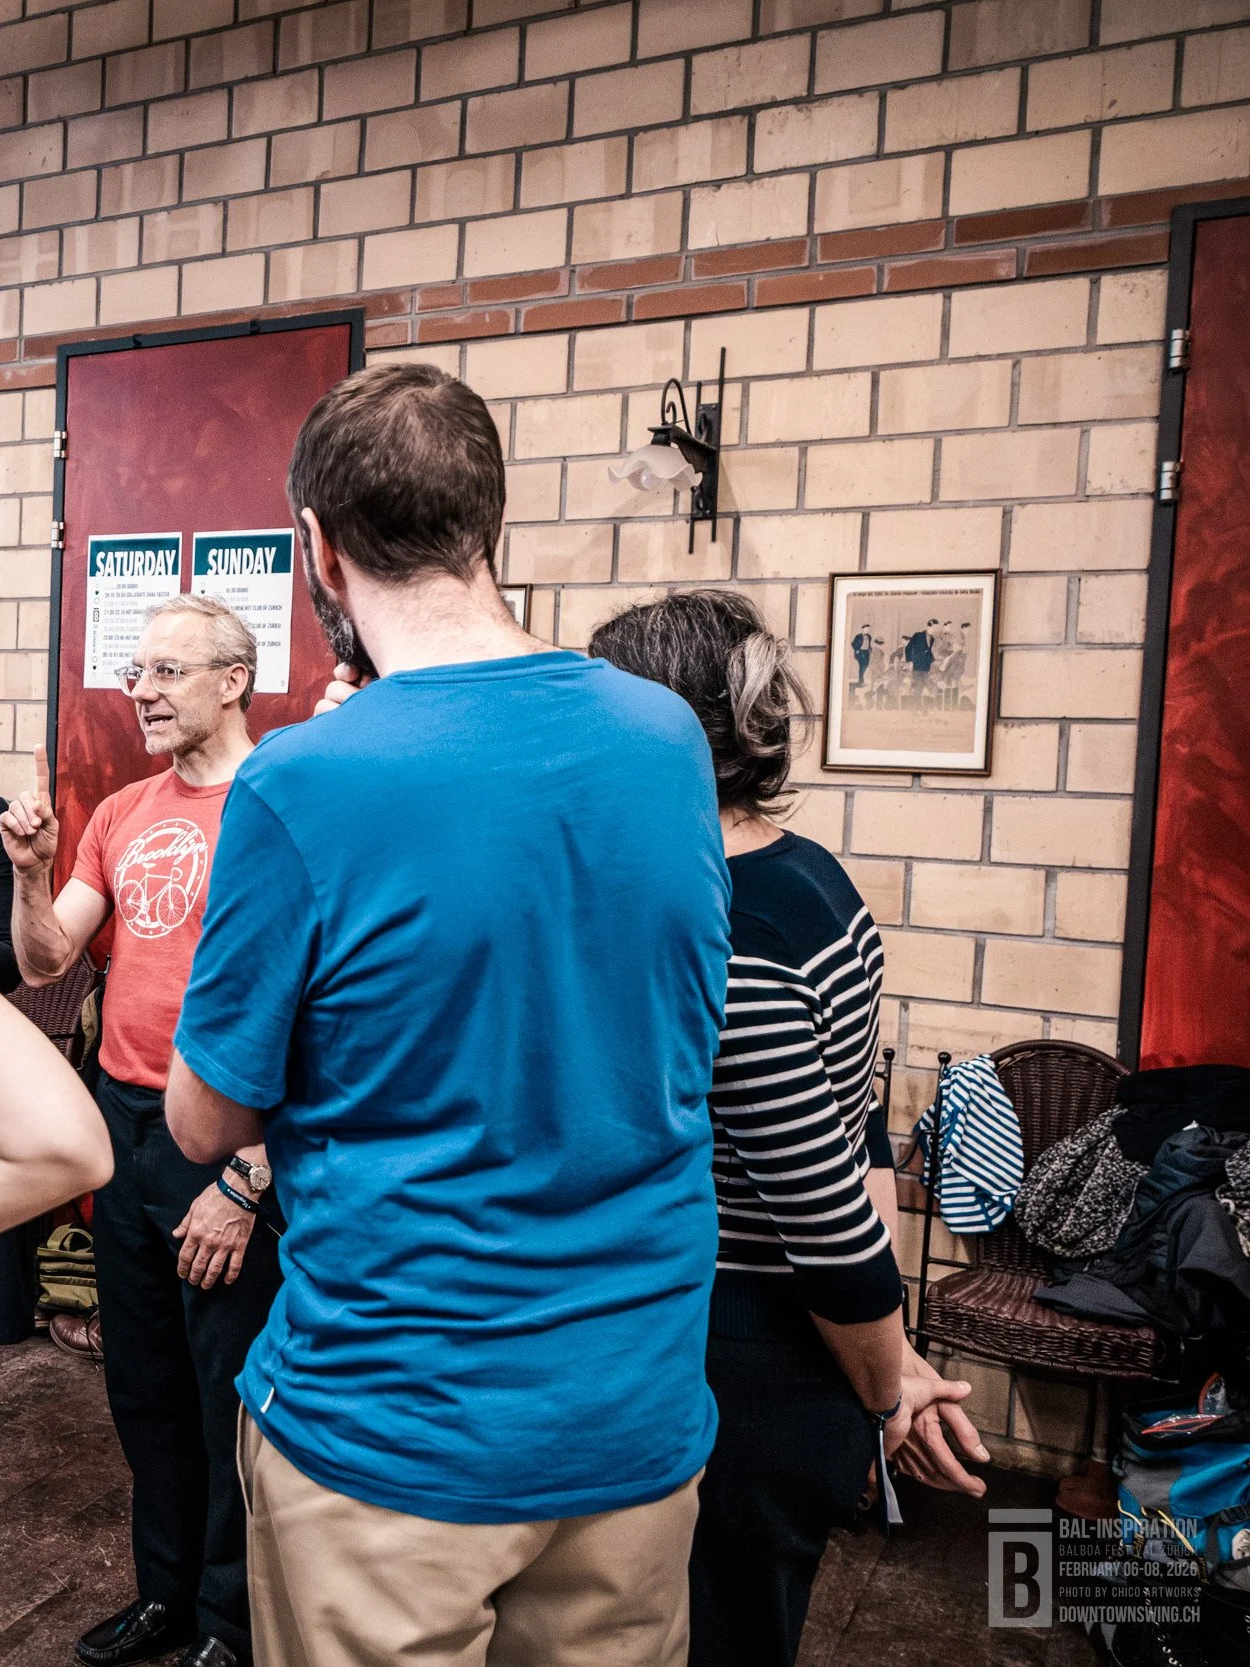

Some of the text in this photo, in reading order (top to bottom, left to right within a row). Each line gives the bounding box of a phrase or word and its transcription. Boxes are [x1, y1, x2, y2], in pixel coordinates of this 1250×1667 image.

[95, 549, 176, 577] SATURDAY
[207, 546, 276, 576] SUNDAY
[115, 830, 208, 872] Brooklyn
